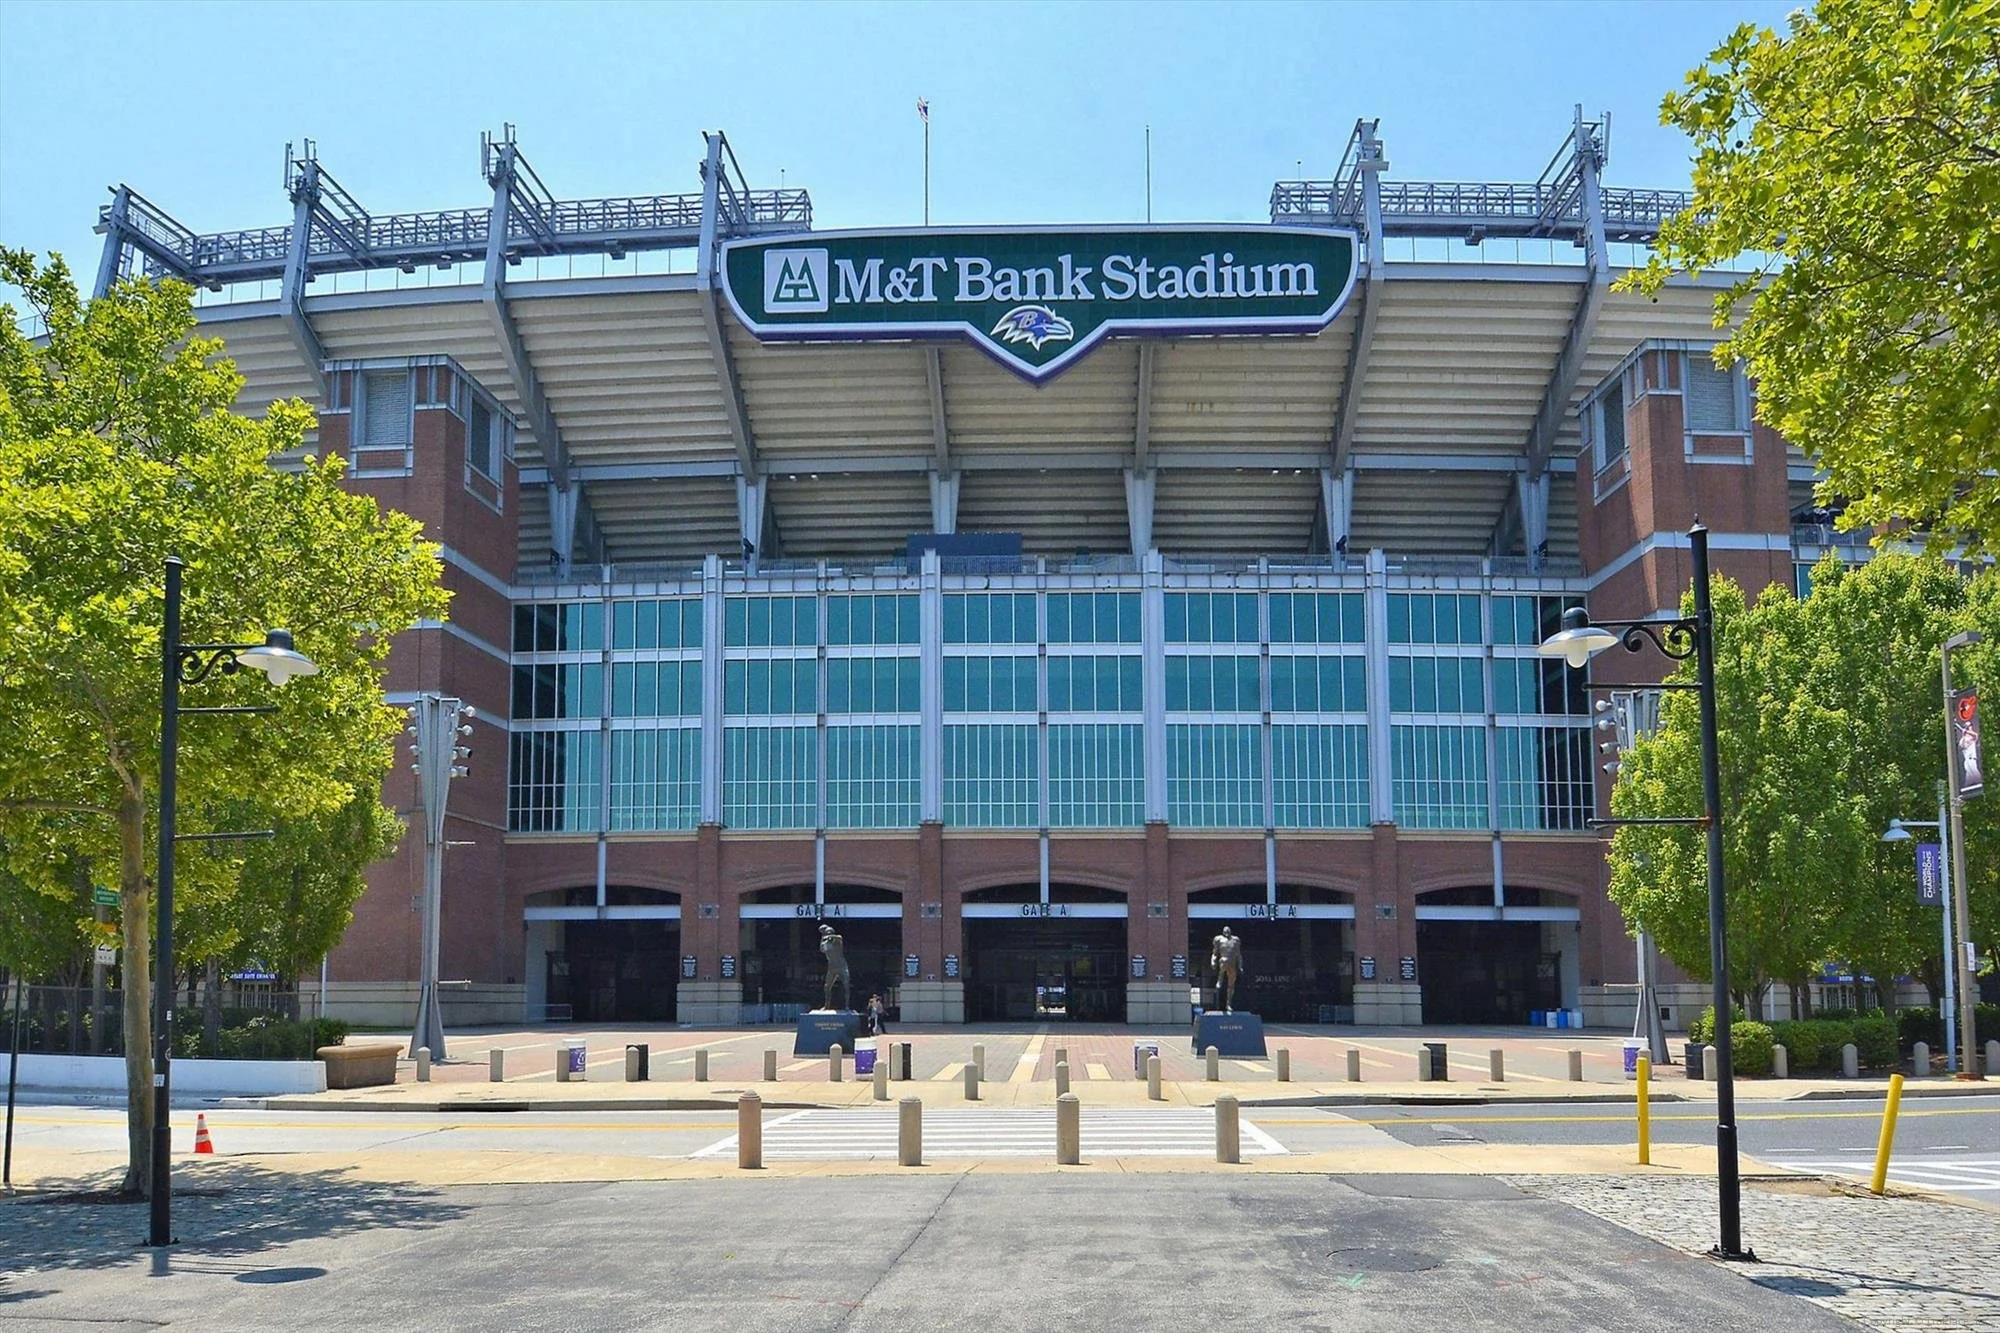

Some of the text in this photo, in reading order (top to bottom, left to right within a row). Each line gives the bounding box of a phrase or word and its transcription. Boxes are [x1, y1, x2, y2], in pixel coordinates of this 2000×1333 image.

[834, 252, 1319, 304] M&T Bank Stadium
[796, 903, 841, 917] GATE A
[1022, 903, 1067, 917] GATE A
[1250, 903, 1295, 917] GATE A
